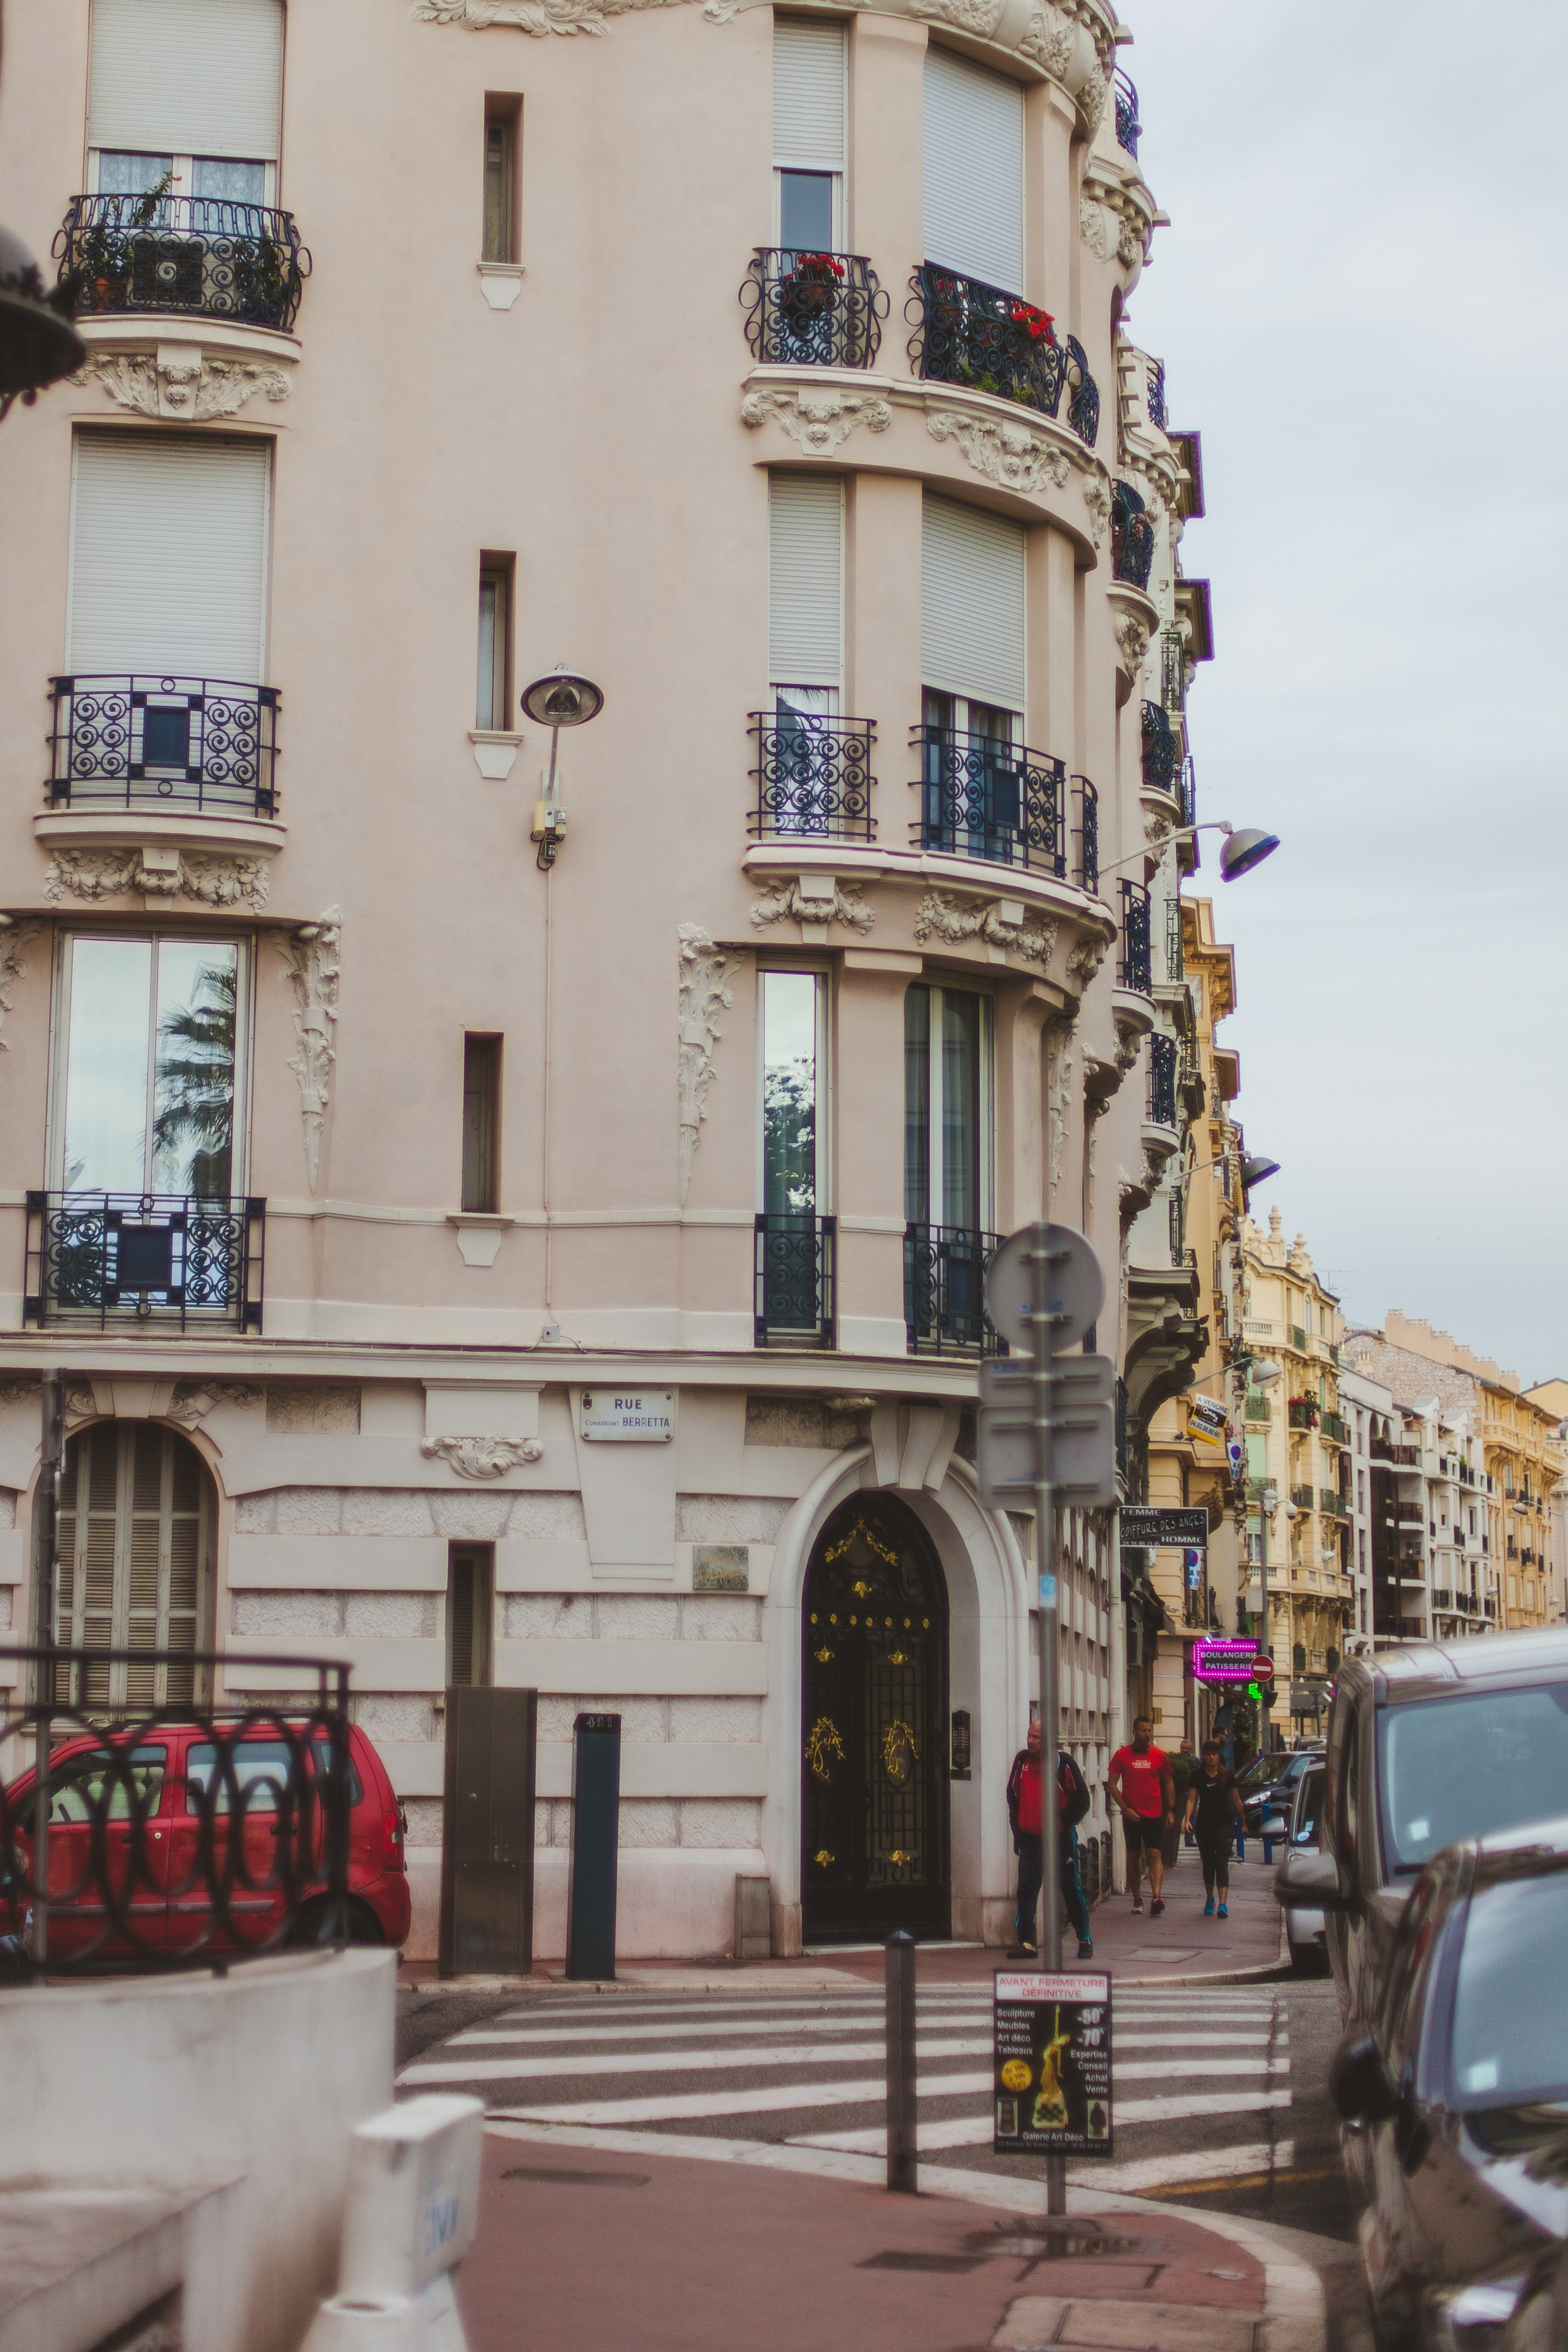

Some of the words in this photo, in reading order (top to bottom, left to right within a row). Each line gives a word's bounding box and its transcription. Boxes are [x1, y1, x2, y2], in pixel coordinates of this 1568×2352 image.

[615, 1398, 642, 1409] RUE
[1204, 1399, 1229, 1414] VENDRE
[623, 1417, 670, 1427] BERRETTA
[1120, 1521, 1158, 1538] COIFFURE
[1160, 1519, 1176, 1531] DES
[1179, 1513, 1205, 1528] ANGES
[1038, 1978, 1105, 1987] FERMETURE
[1022, 1987, 1082, 1998] DÉFINITIVE
[997, 2008, 1035, 2019] Sculpture
[997, 2021, 1030, 2030] Meubles
[997, 2034, 1009, 2042] Art
[997, 2046, 1033, 2054] Tableaux
[1071, 2049, 1107, 2060] Expertise
[1078, 2062, 1107, 2070] Conseil
[1085, 2073, 1108, 2082] Achat
[1085, 2085, 1108, 2094] Vente
[1023, 2132, 1049, 2140] Galerie
[1052, 2133, 1062, 2141] Art
[1065, 2133, 1084, 2141] Déco
